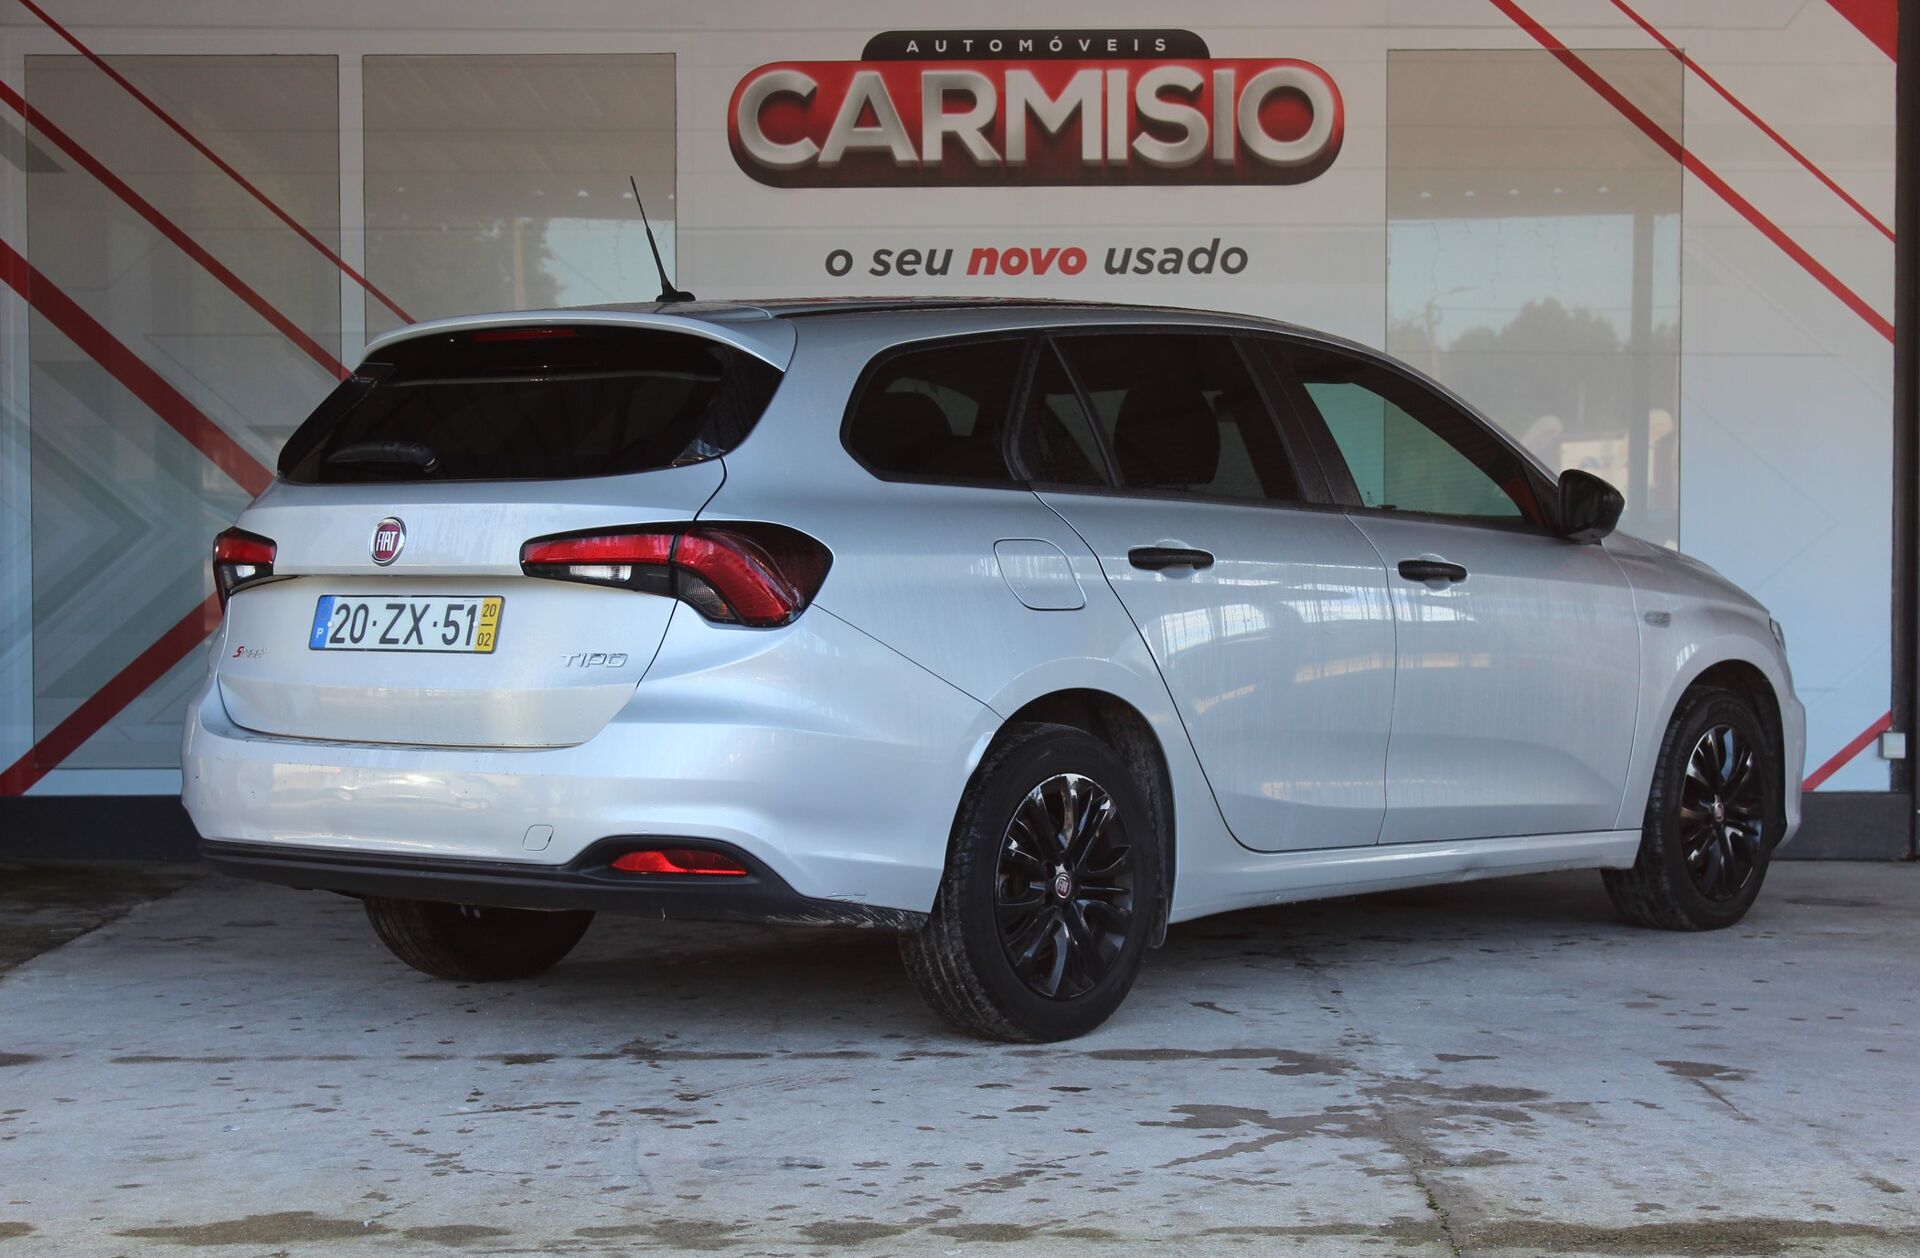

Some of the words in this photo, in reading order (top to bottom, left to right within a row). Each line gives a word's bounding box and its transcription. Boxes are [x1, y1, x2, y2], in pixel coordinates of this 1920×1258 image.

[905, 36, 1166, 53] AUTOMÓVEIS
[737, 65, 1335, 169] CARMISIO
[824, 248, 853, 277] o
[868, 247, 953, 277] seu
[965, 247, 1088, 276] novo
[1104, 238, 1249, 276] usado
[375, 530, 398, 552] FIAT
[482, 603, 497, 618] 20
[315, 627, 324, 639] P
[476, 632, 492, 647] 02
[560, 653, 629, 669] TIPO
